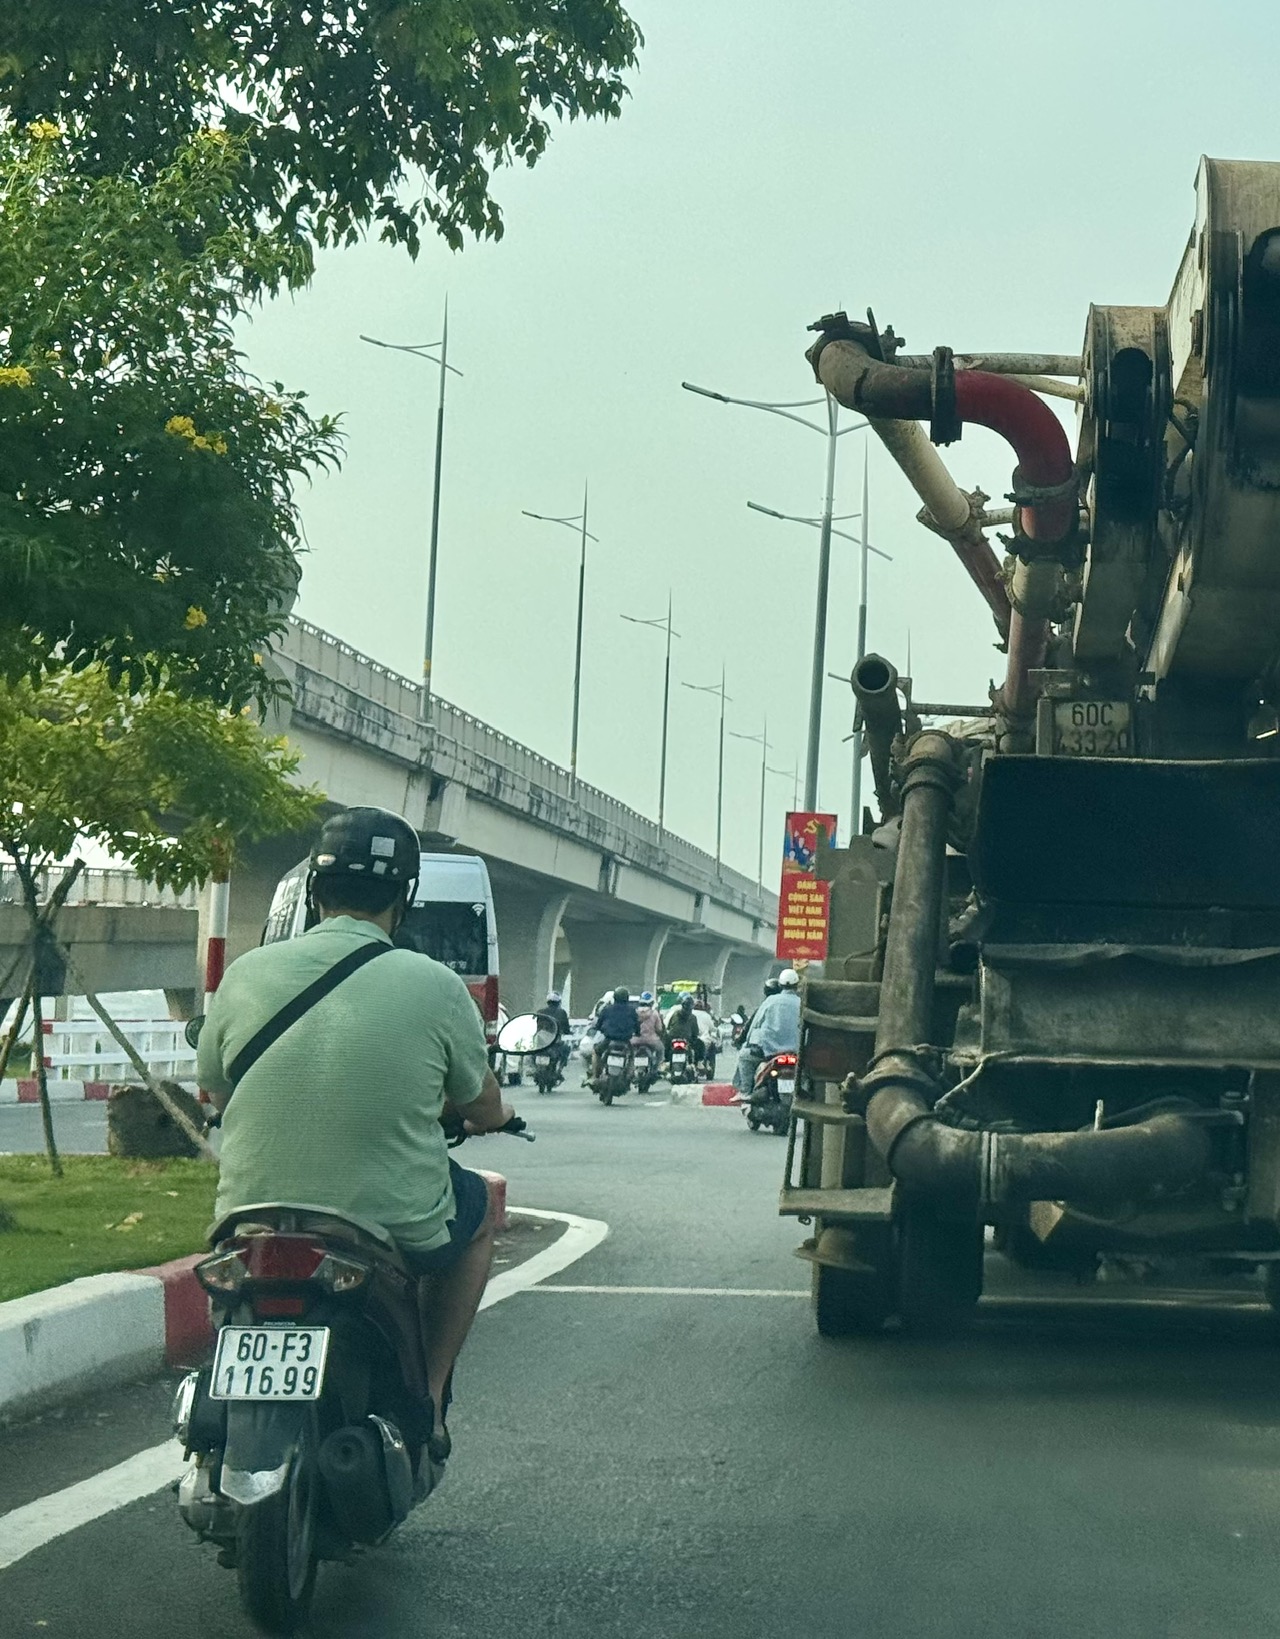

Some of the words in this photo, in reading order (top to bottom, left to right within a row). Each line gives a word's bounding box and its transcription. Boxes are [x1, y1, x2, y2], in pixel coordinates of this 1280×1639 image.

[1072, 703, 1113, 727] 60C
[236, 1332, 313, 1362] 60-F3
[224, 1365, 318, 1396] 116.99
